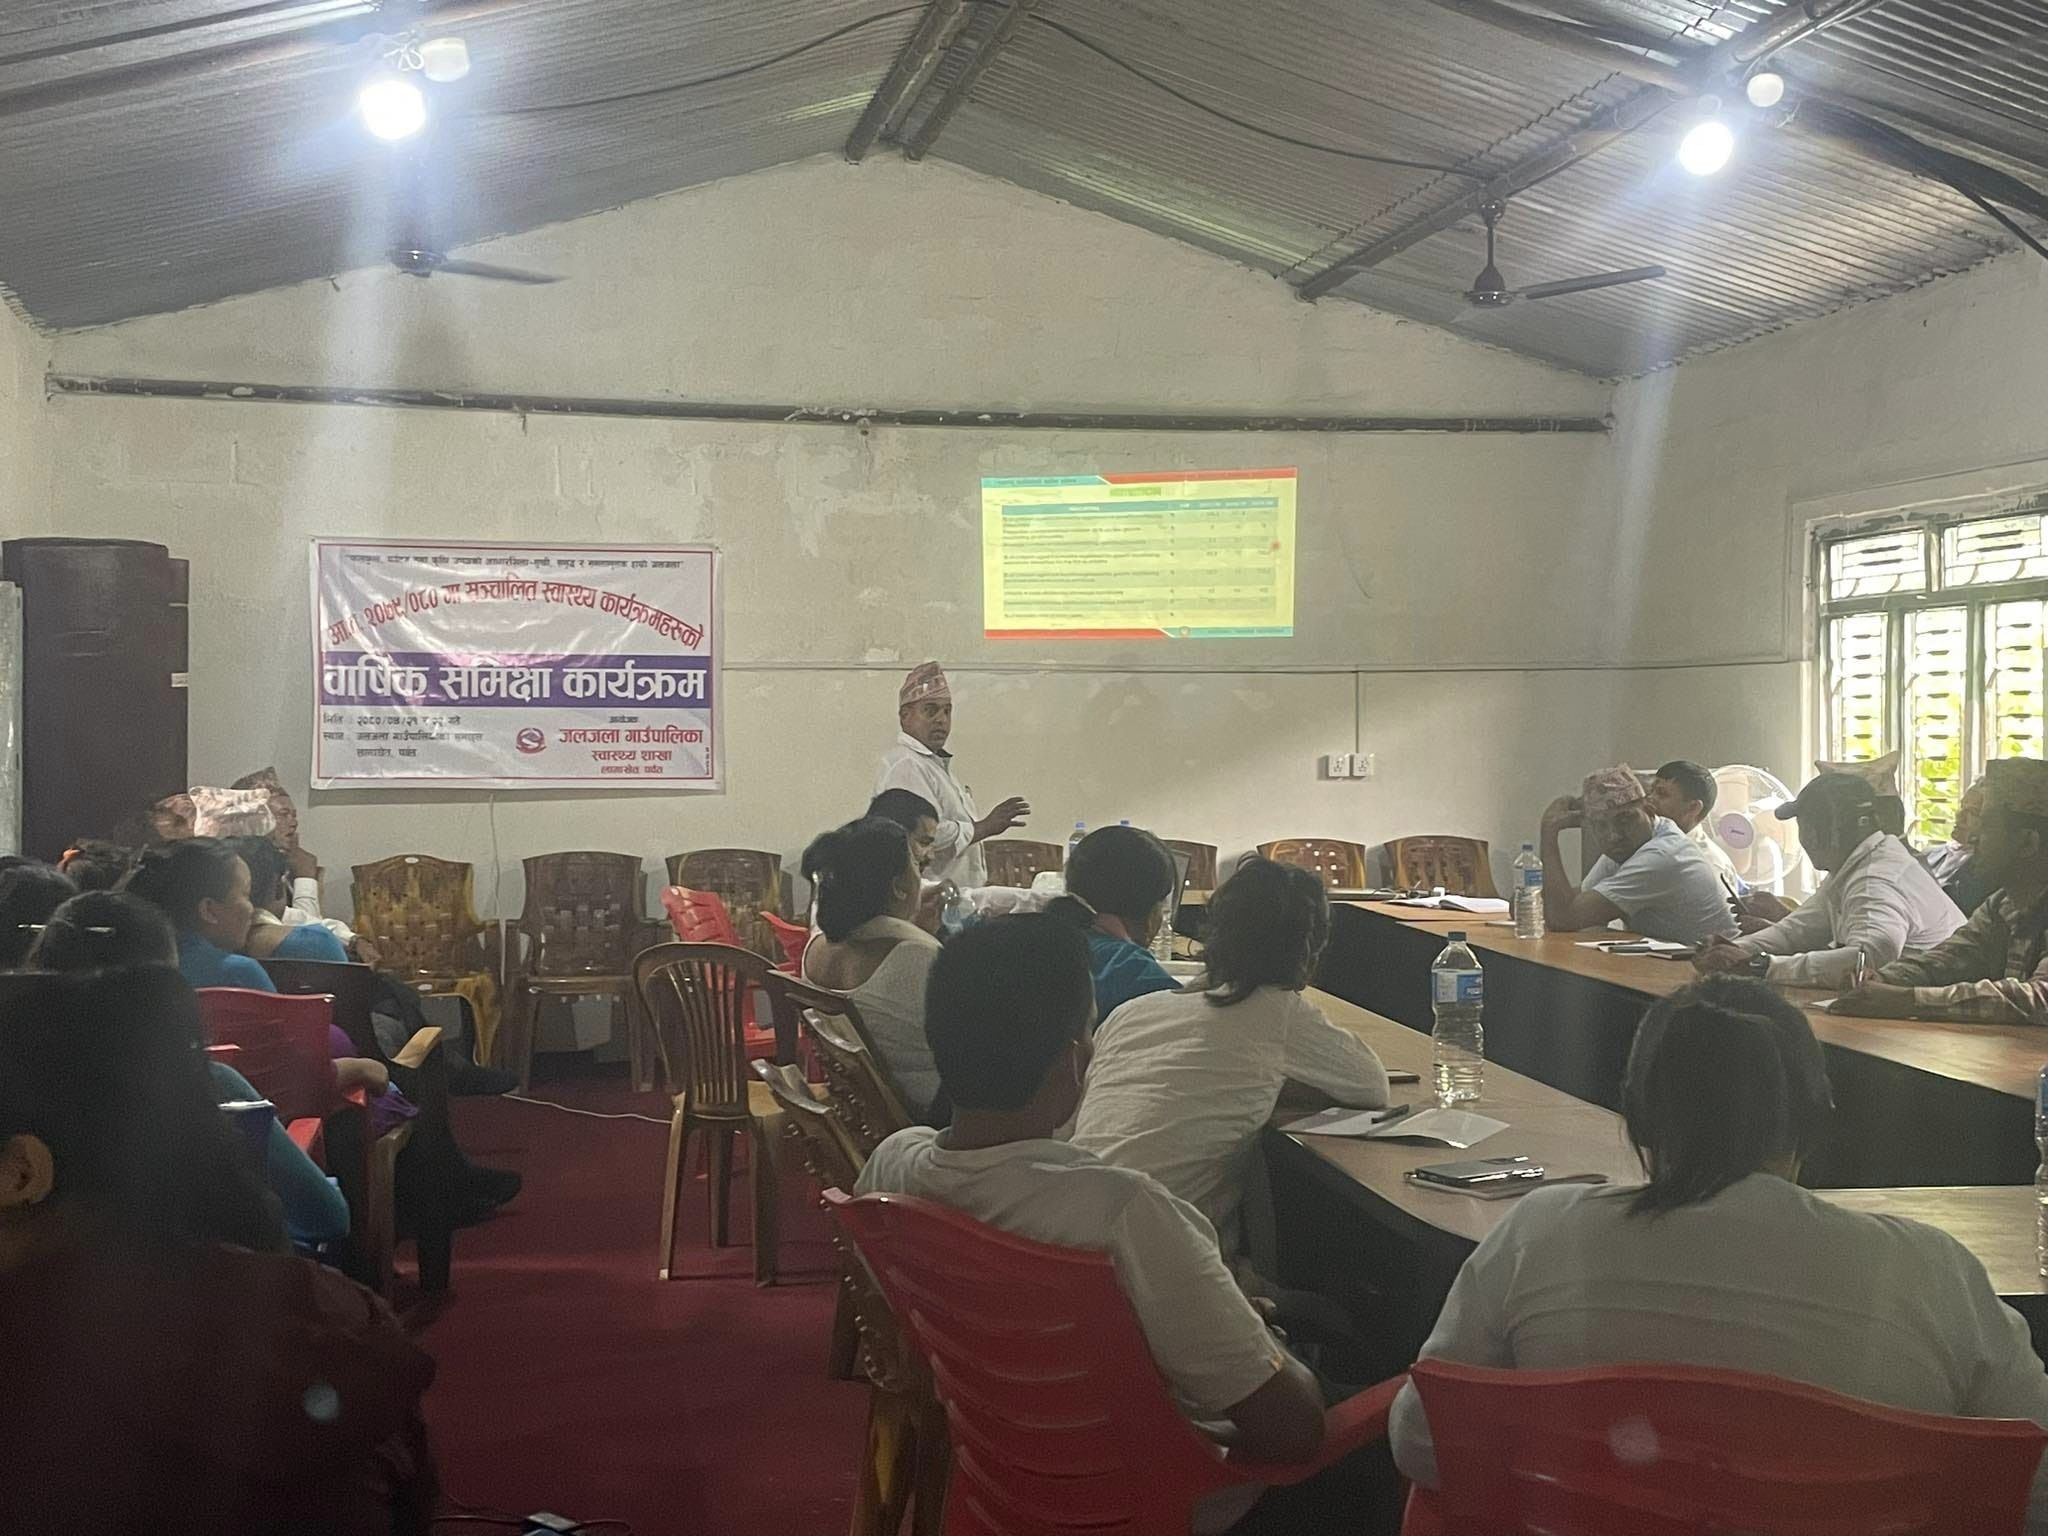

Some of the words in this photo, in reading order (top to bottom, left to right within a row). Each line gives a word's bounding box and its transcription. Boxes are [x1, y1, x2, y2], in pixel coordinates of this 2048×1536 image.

[542, 581, 598, 609] स्वास्थ्य
[323, 655, 430, 698] वार्षिक
[563, 660, 707, 701] कार्यक्रम
[559, 728, 620, 744] जलजला
[591, 750, 637, 762] स्वास्थ्य
[641, 750, 672, 762] शाखा
